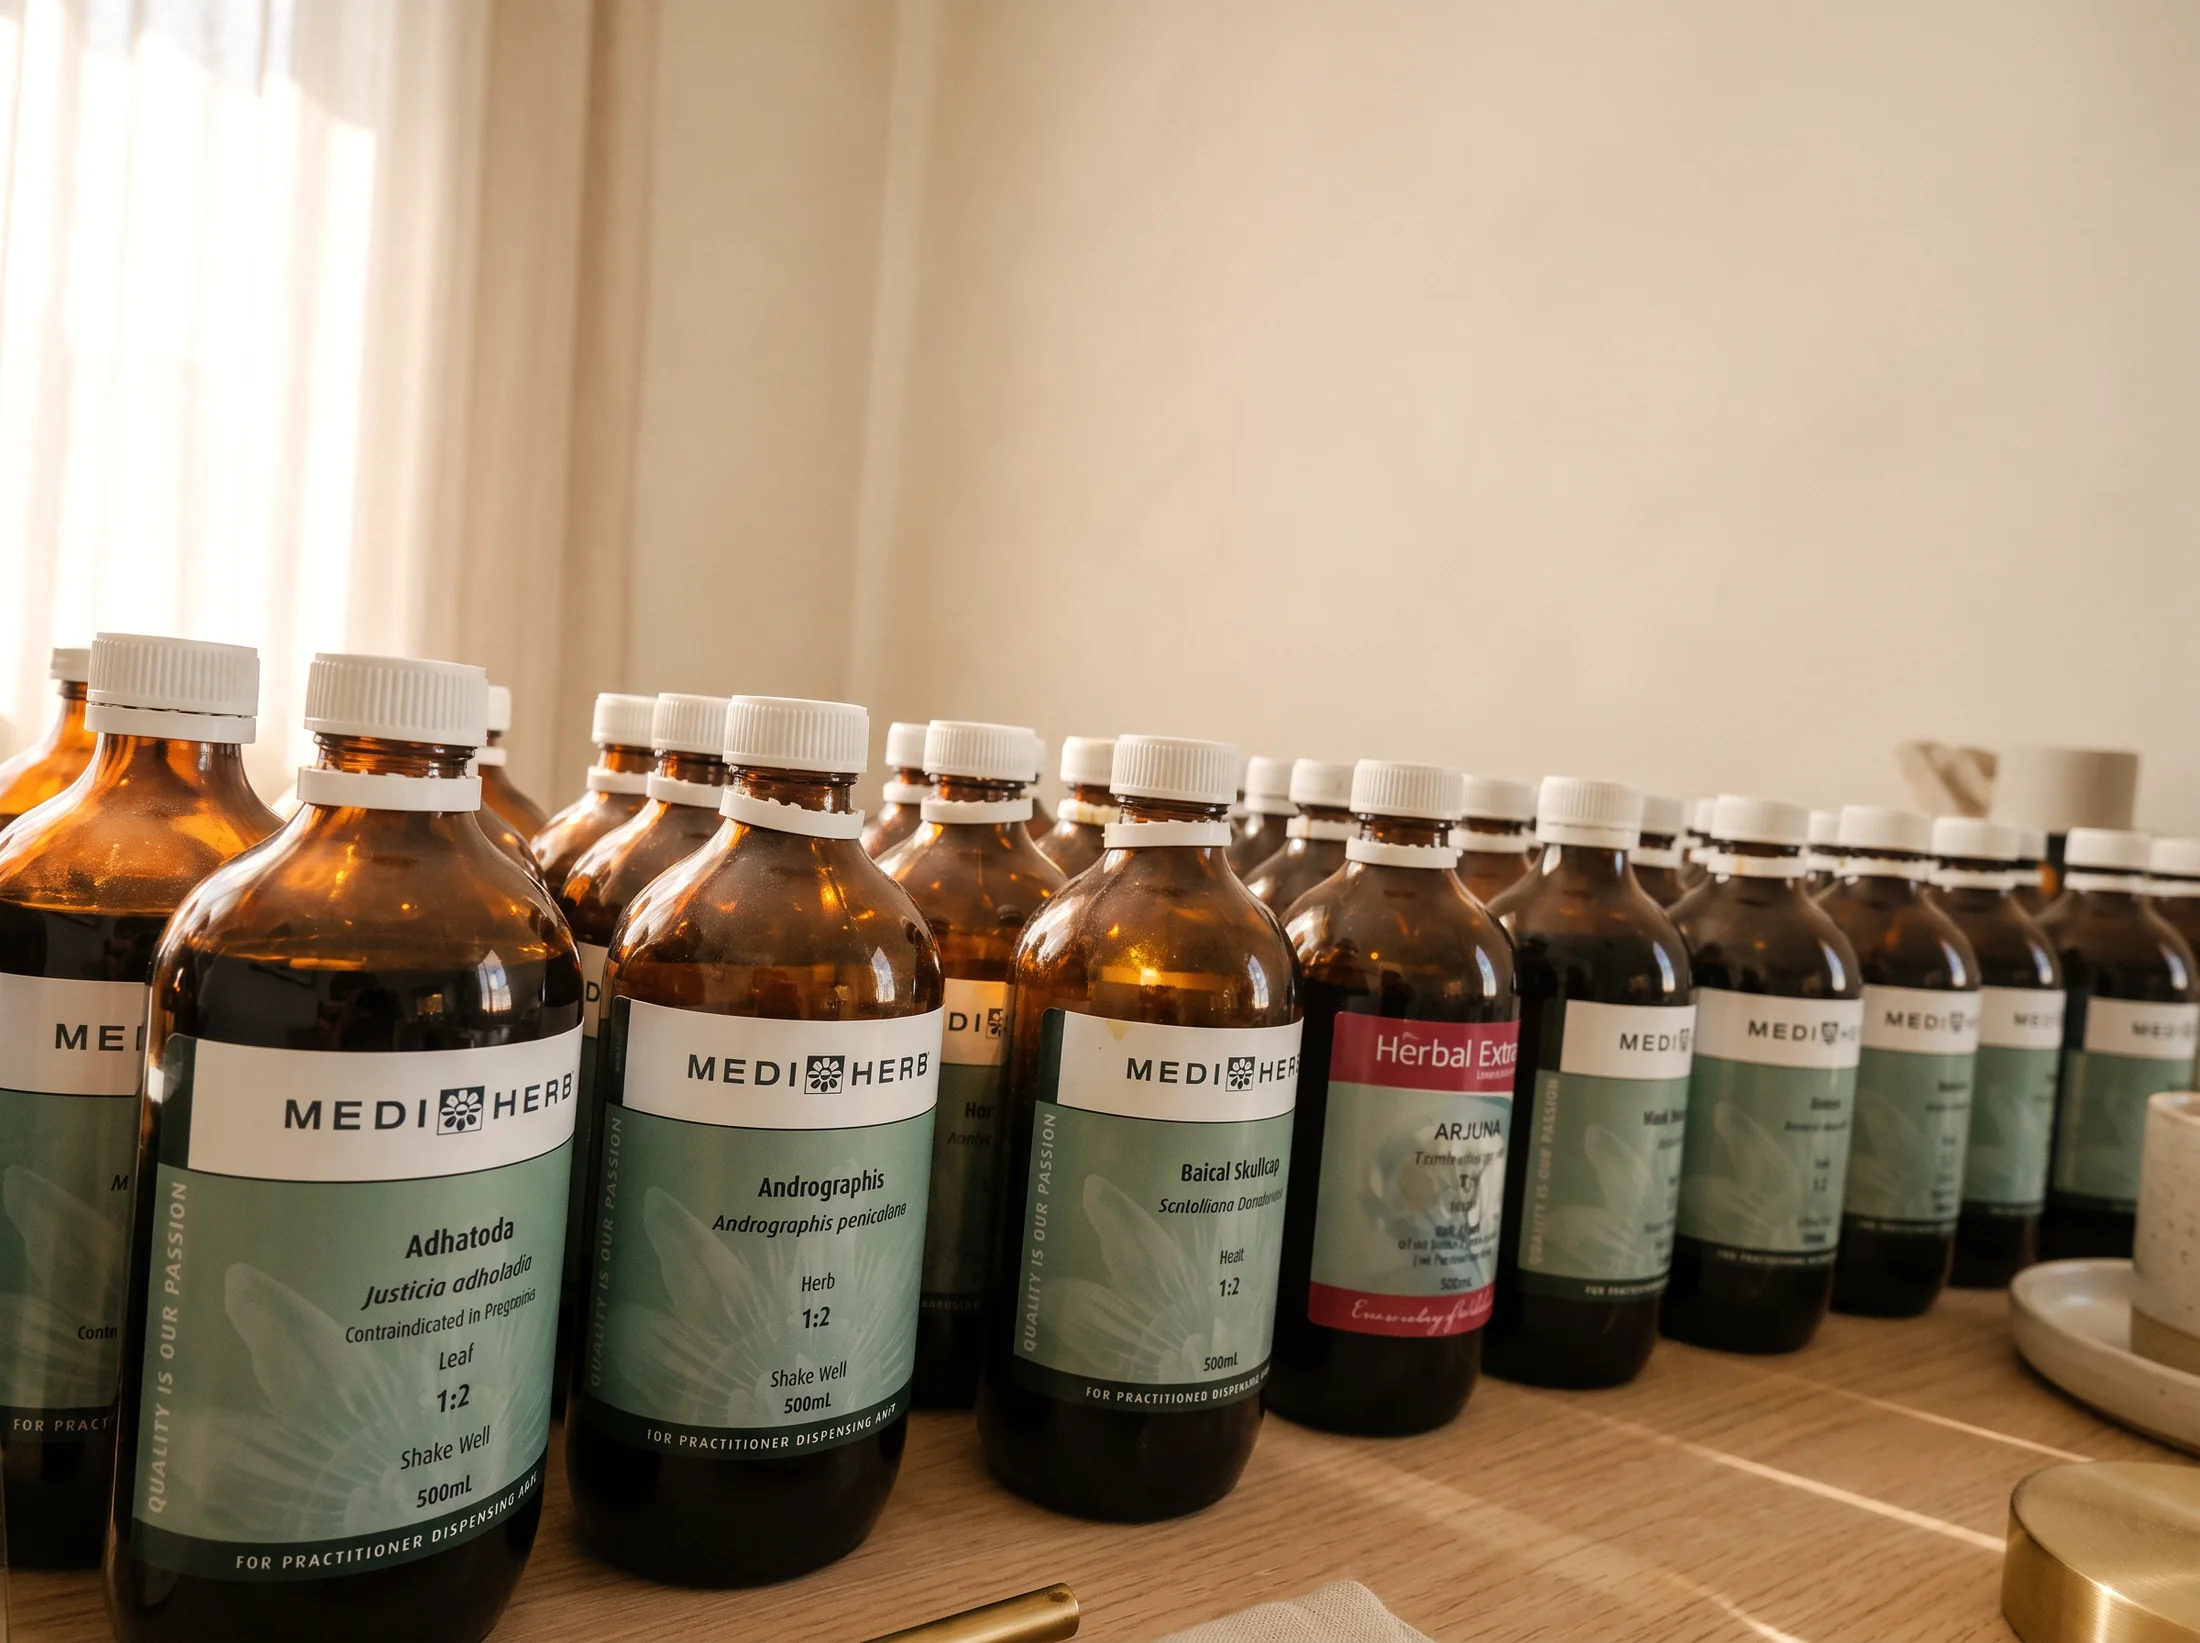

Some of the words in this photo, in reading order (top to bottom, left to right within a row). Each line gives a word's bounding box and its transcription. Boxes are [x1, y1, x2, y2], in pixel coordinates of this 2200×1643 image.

[55, 1023, 142, 1051] ME
[1619, 1033, 1677, 1051] MEDI
[1748, 1019, 1817, 1041] MEDI
[1376, 1034, 1472, 1068] Herbal
[687, 1053, 797, 1087] MEDI
[851, 1052, 928, 1086] HERB
[1126, 1057, 1220, 1085] MEDI
[284, 1098, 427, 1130] MEDI
[493, 1072, 573, 1119] HERB
[1434, 1119, 1501, 1141] ARJUNA
[605, 1117, 622, 1211] PASSION
[1037, 1113, 1056, 1195] PASSION
[1181, 1161, 1231, 1183] Baical
[1234, 1157, 1280, 1180] Skullcap
[758, 1168, 884, 1202] Andrographis
[712, 1215, 834, 1238] Andrographis
[1033, 1202, 1048, 1241] OUR
[164, 1182, 187, 1296] PASSION
[405, 1217, 515, 1259] Adhatoda
[601, 1218, 614, 1263] OUR
[1031, 1248, 1044, 1267] IS
[361, 1278, 447, 1310] Justicia
[801, 1272, 836, 1293] Herb
[1219, 1276, 1241, 1297] 1:2
[345, 1309, 465, 1343] Contraindicated
[468, 1308, 481, 1325] in
[802, 1306, 831, 1329] 1:2
[1023, 1272, 1042, 1352] QUALITY
[159, 1306, 179, 1360] OUR
[439, 1342, 475, 1371] Leaf
[157, 1371, 174, 1395] IS
[770, 1369, 815, 1388] Shake
[819, 1360, 848, 1382] Well
[436, 1383, 471, 1413] 1:2
[784, 1392, 832, 1414] 500mL
[1085, 1386, 1111, 1401] FOR
[14, 1418, 44, 1432] FOR
[647, 1428, 672, 1445] FOR
[679, 1435, 789, 1450] PRACTITIONER
[796, 1416, 872, 1446] DISPENSING
[148, 1402, 171, 1514] QUALITY
[400, 1442, 453, 1470] Shake
[459, 1424, 491, 1454] Well
[416, 1474, 473, 1509] 500mL
[236, 1555, 271, 1570] FOR
[282, 1534, 423, 1569] PRACTITIONER
[431, 1491, 515, 1543] DISPENSING
